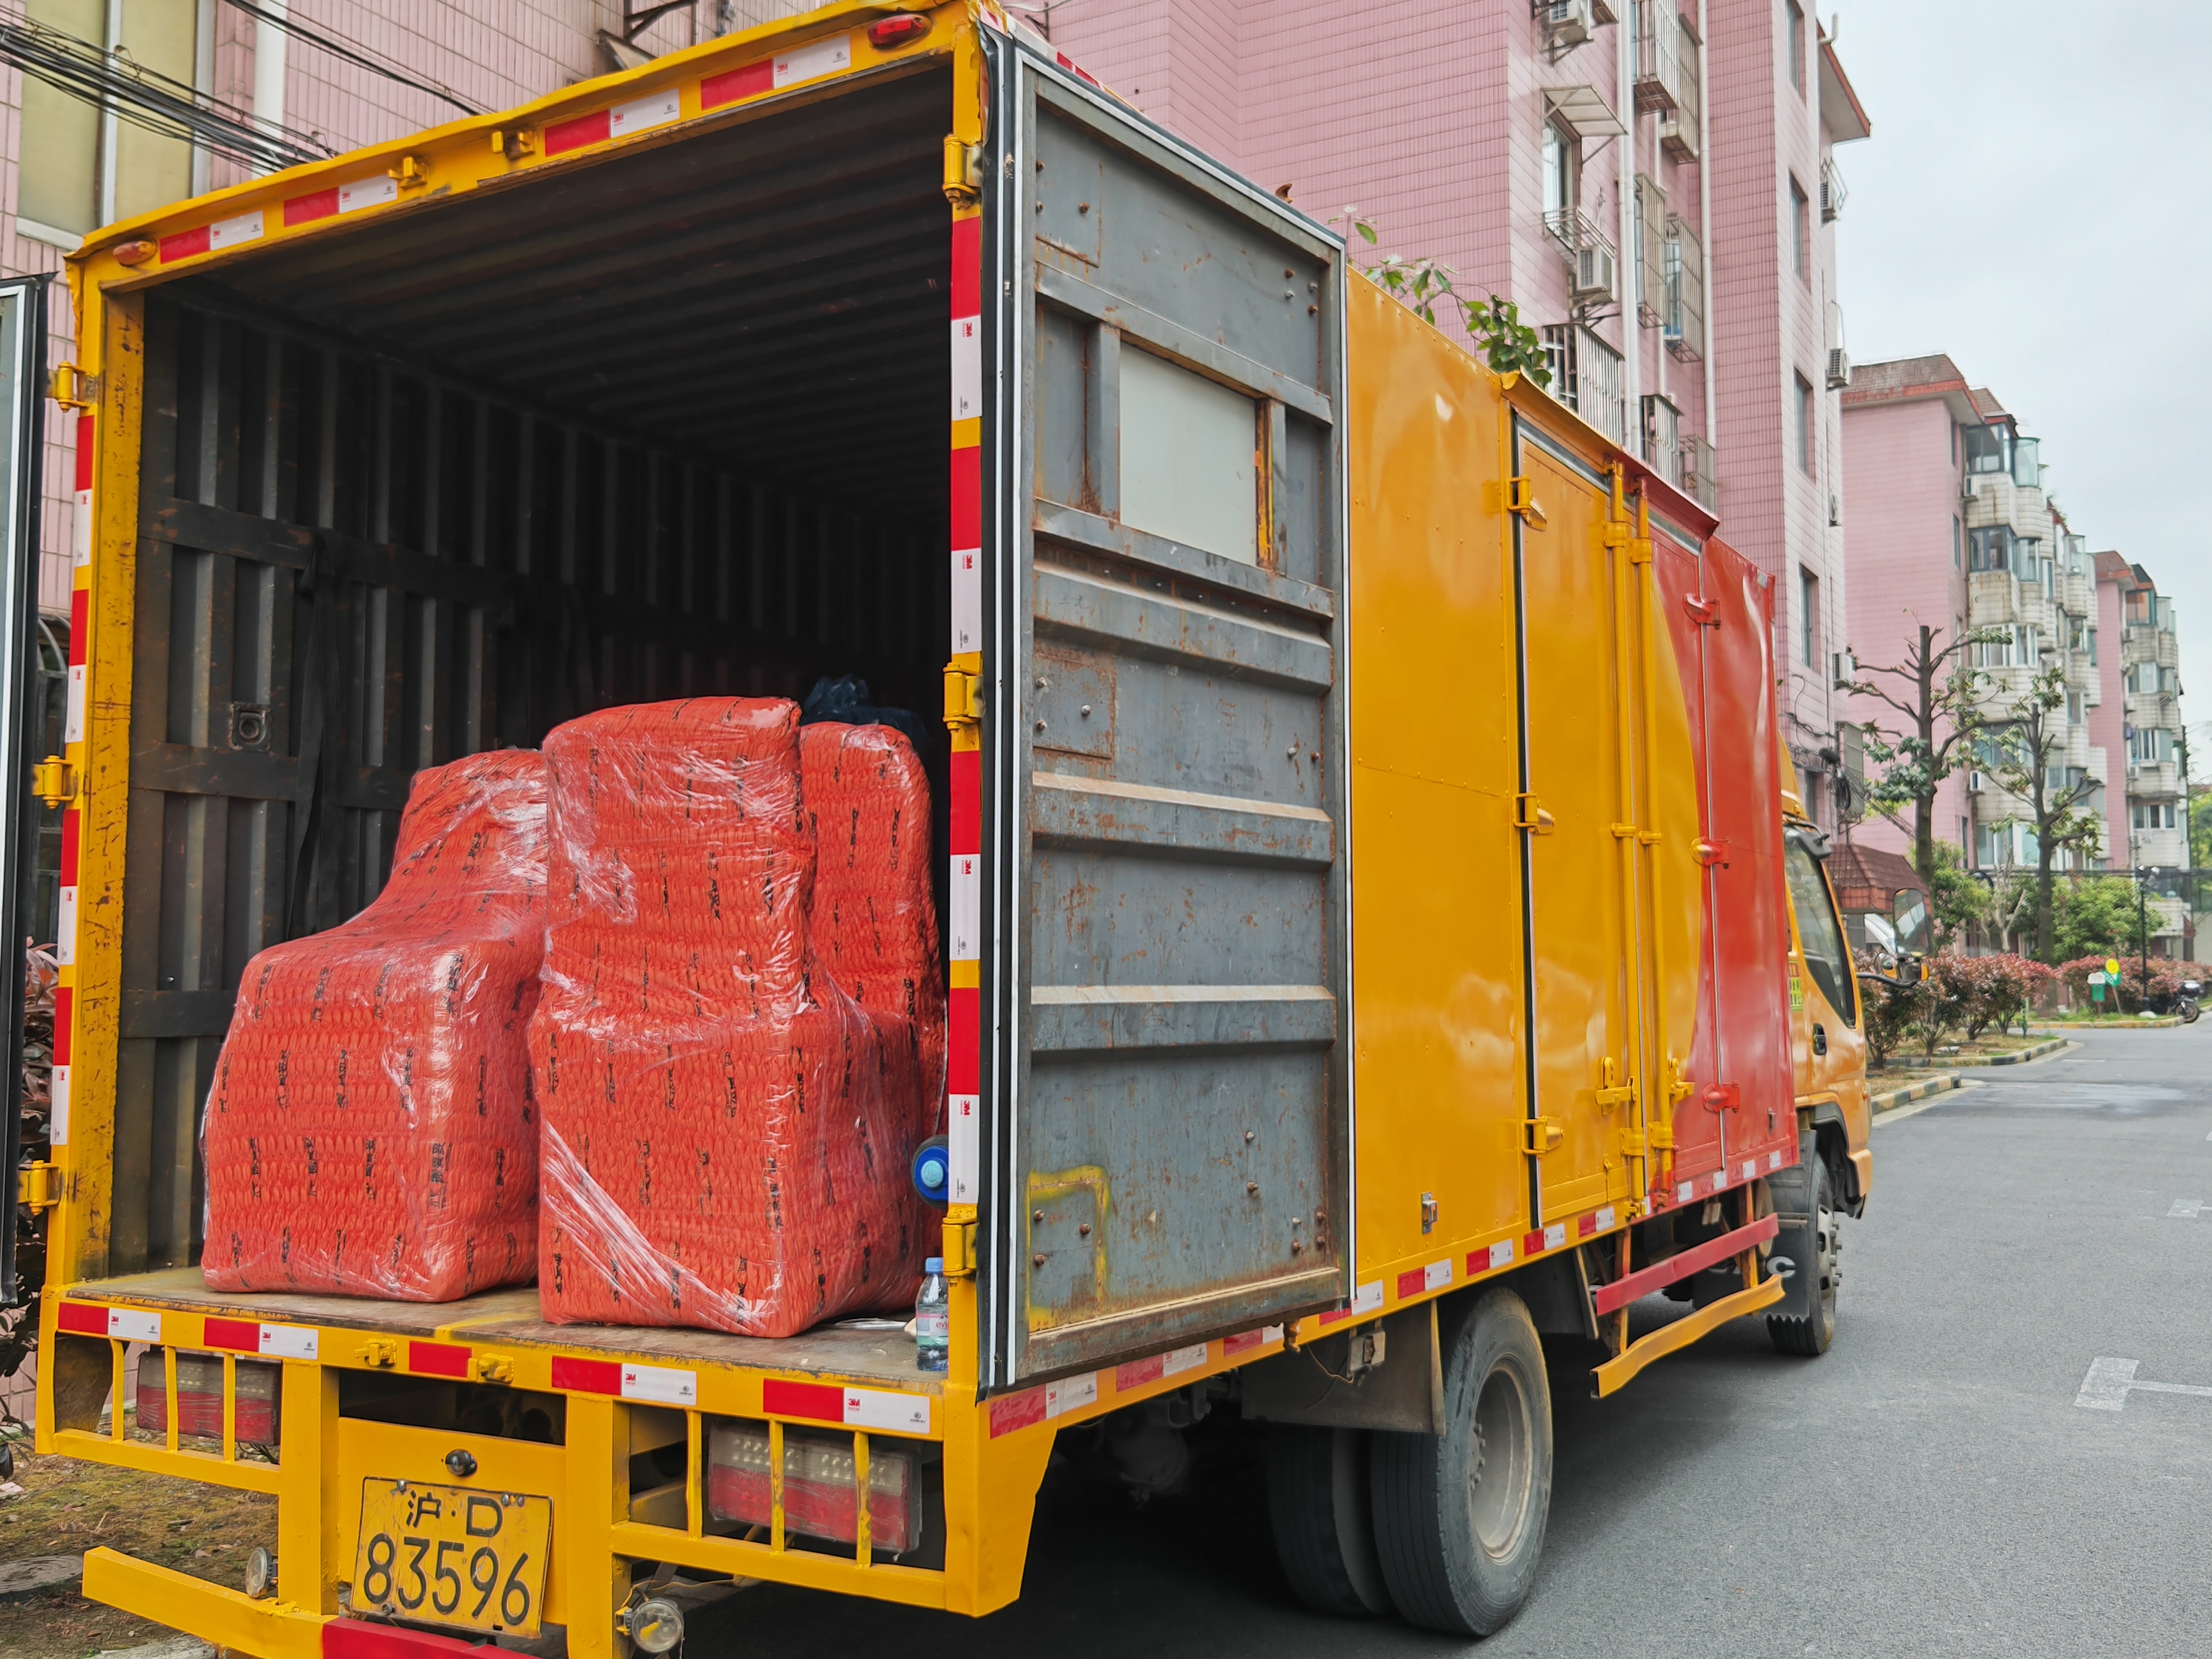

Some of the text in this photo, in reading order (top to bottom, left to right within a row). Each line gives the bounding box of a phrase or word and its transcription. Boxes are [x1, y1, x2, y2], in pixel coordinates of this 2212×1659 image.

[966, 322, 972, 337] 3M
[966, 555, 972, 569] 3M
[965, 860, 971, 874] 3M
[964, 1100, 970, 1115] 3M
[936, 1319, 949, 1327] evi
[848, 1398, 860, 1406] 3M
[363, 1533, 530, 1626] 83596
